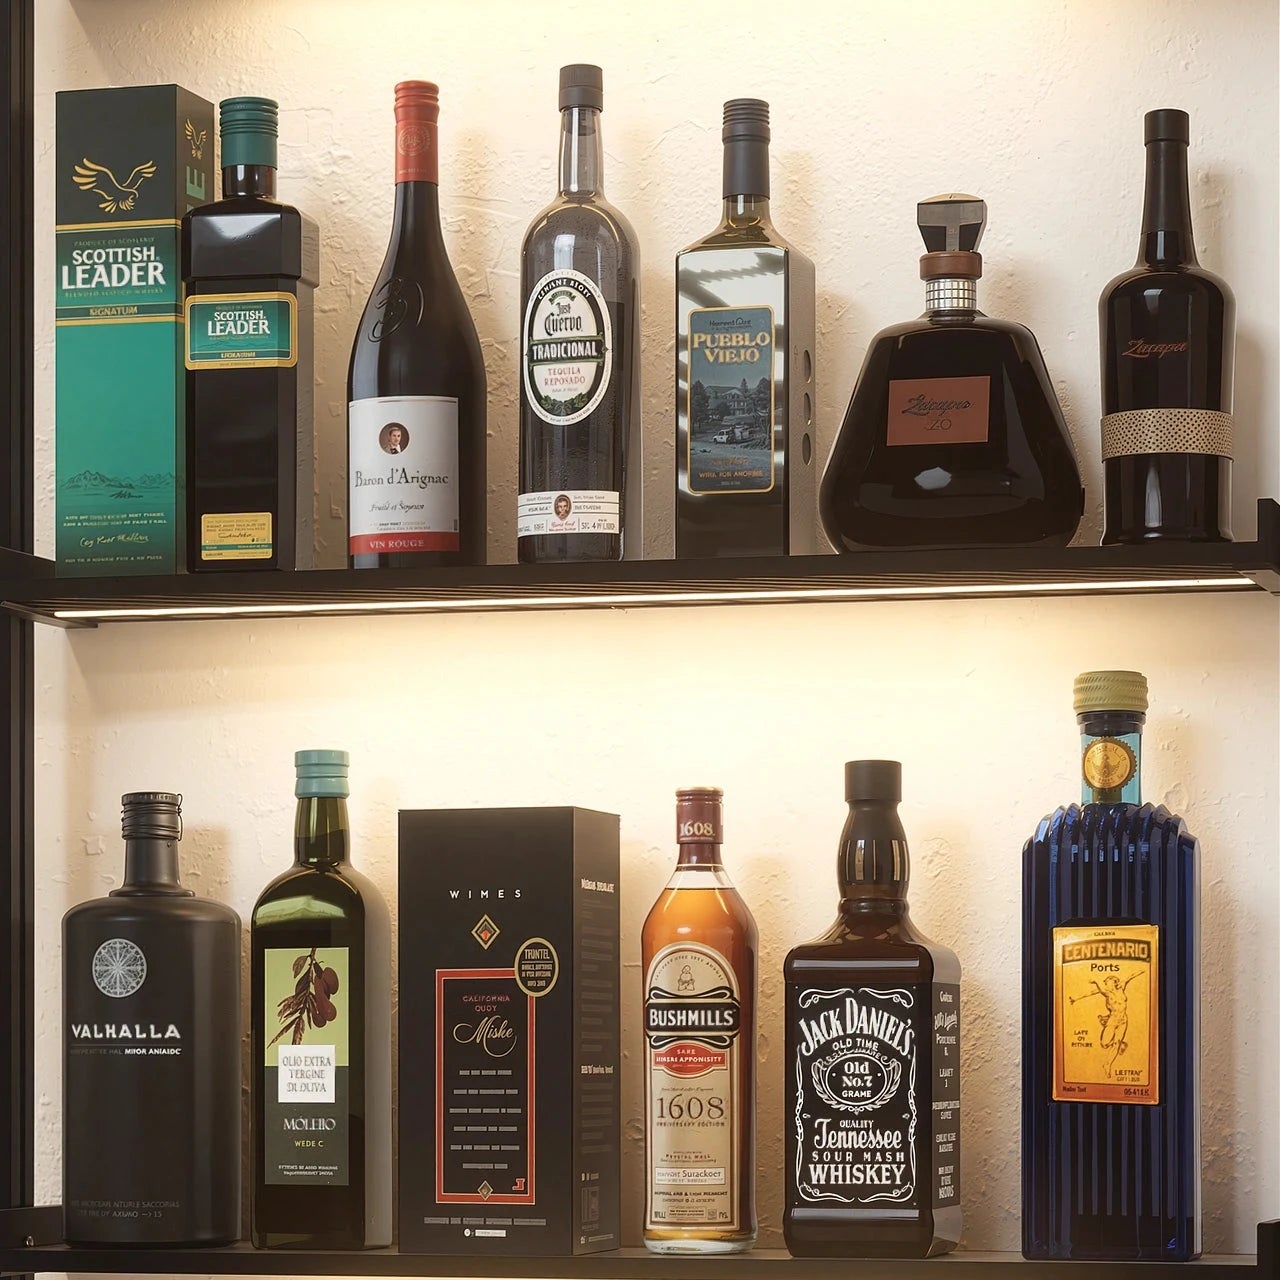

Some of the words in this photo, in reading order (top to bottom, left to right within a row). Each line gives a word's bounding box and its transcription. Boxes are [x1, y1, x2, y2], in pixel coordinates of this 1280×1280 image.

[72, 246, 155, 265] SCOTTISH
[61, 262, 166, 290] LEADER
[214, 310, 264, 321] SCOTTISH
[207, 320, 270, 336] LEADER
[544, 311, 582, 337] Cuervo
[693, 331, 770, 349] PUEBLO
[532, 341, 597, 361] TRADICIONAL
[704, 348, 760, 364] VIEJO
[369, 540, 385, 549] VIN
[388, 539, 424, 548] ROUGE
[680, 819, 713, 837] 1608
[449, 889, 521, 899] WIMES
[1064, 941, 1149, 960] CENTENARIO
[1091, 963, 1120, 972] Ports
[649, 1009, 734, 1026] BUSHMILLS
[71, 1024, 181, 1039] VALHALLA
[799, 1008, 844, 1056] JACK
[845, 998, 915, 1056] DANIEL'S
[832, 1039, 852, 1051] OLD
[856, 1038, 879, 1051] TIME
[304, 1056, 332, 1067] EXTRA
[844, 1061, 870, 1075] Old
[842, 1076, 873, 1088] No.7
[841, 1090, 872, 1098] GRAME
[657, 1093, 724, 1120] 1608
[839, 1120, 874, 1128] QUALITY
[814, 1118, 902, 1149] Tennessee
[812, 1151, 853, 1162] SOUR
[863, 1151, 905, 1162] MASH
[808, 1164, 906, 1185] WHISKEY
